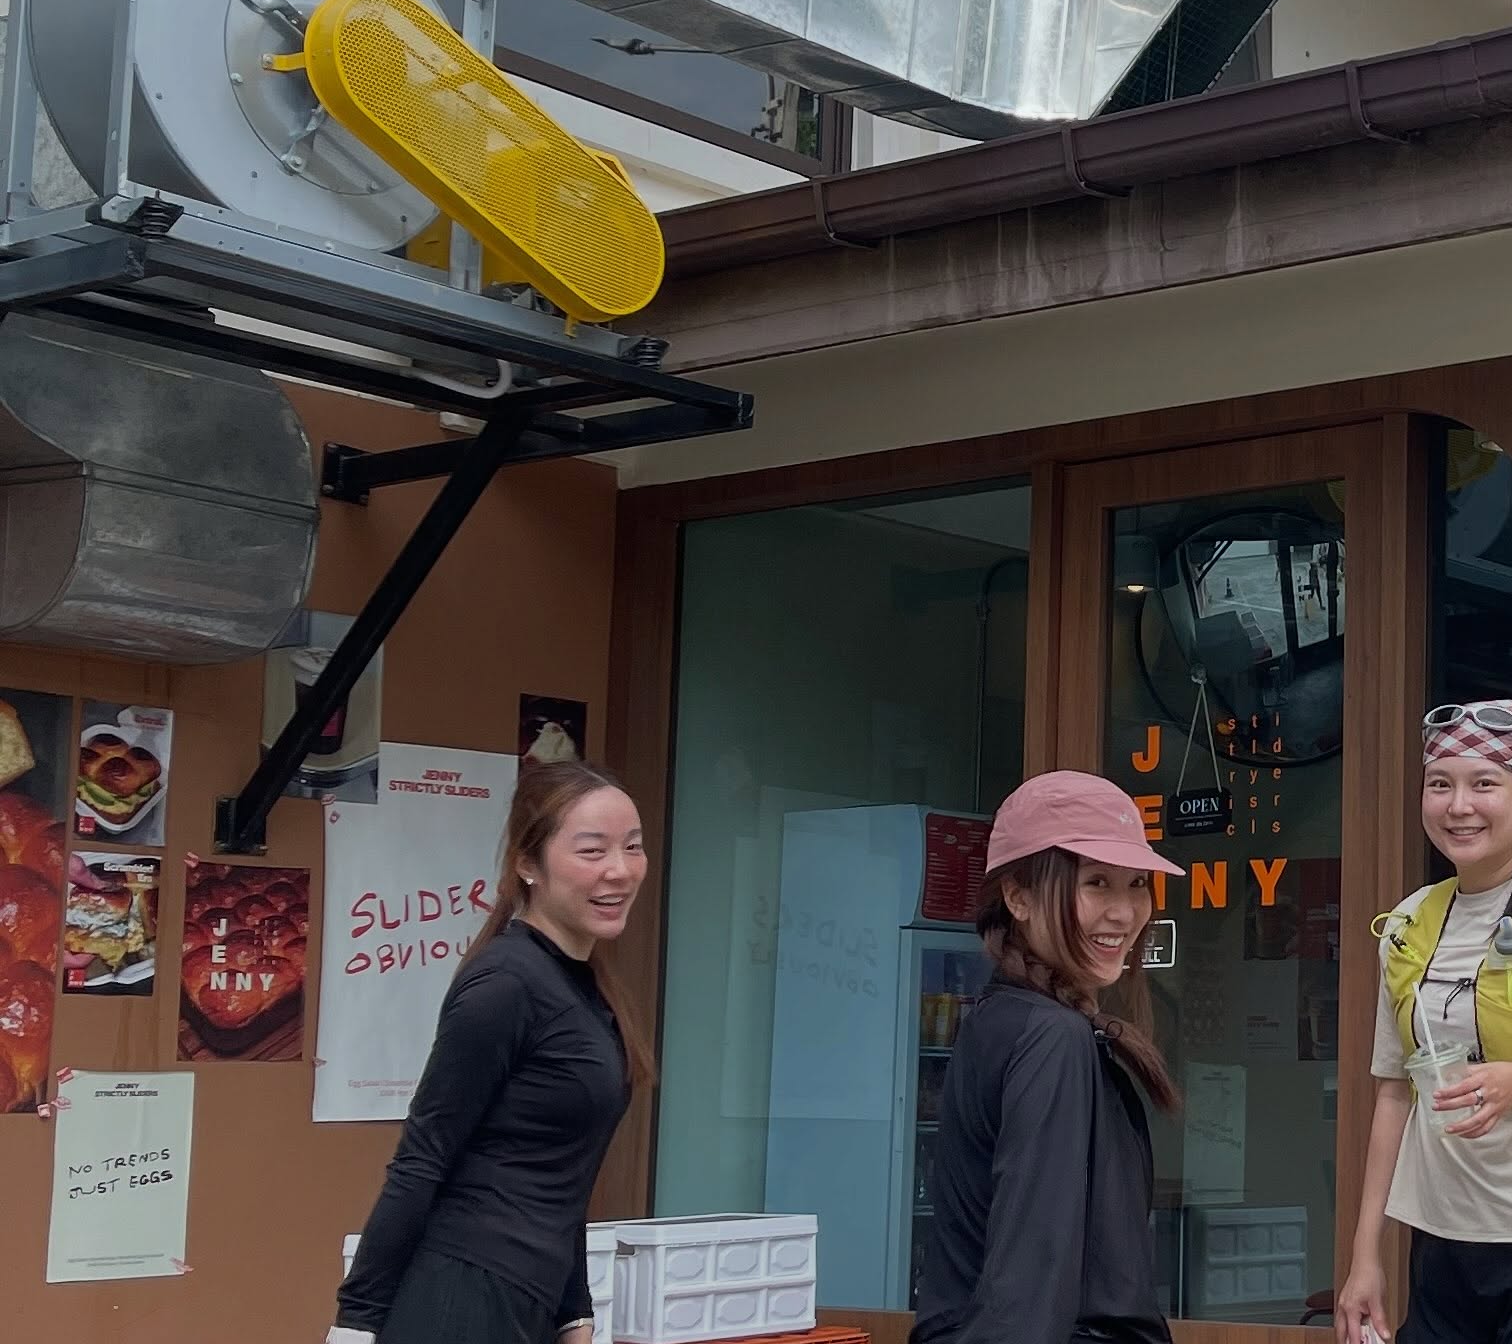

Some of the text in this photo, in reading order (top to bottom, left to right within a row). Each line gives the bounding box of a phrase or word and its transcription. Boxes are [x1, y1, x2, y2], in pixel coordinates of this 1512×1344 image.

[422, 769, 463, 782] JENNY
[389, 780, 491, 798] STRICTLY SLIDERS
[1180, 797, 1220, 814] OPEN
[68, 1148, 171, 1179] NO TRENDS
[69, 1170, 173, 1200] JUST EGGS
